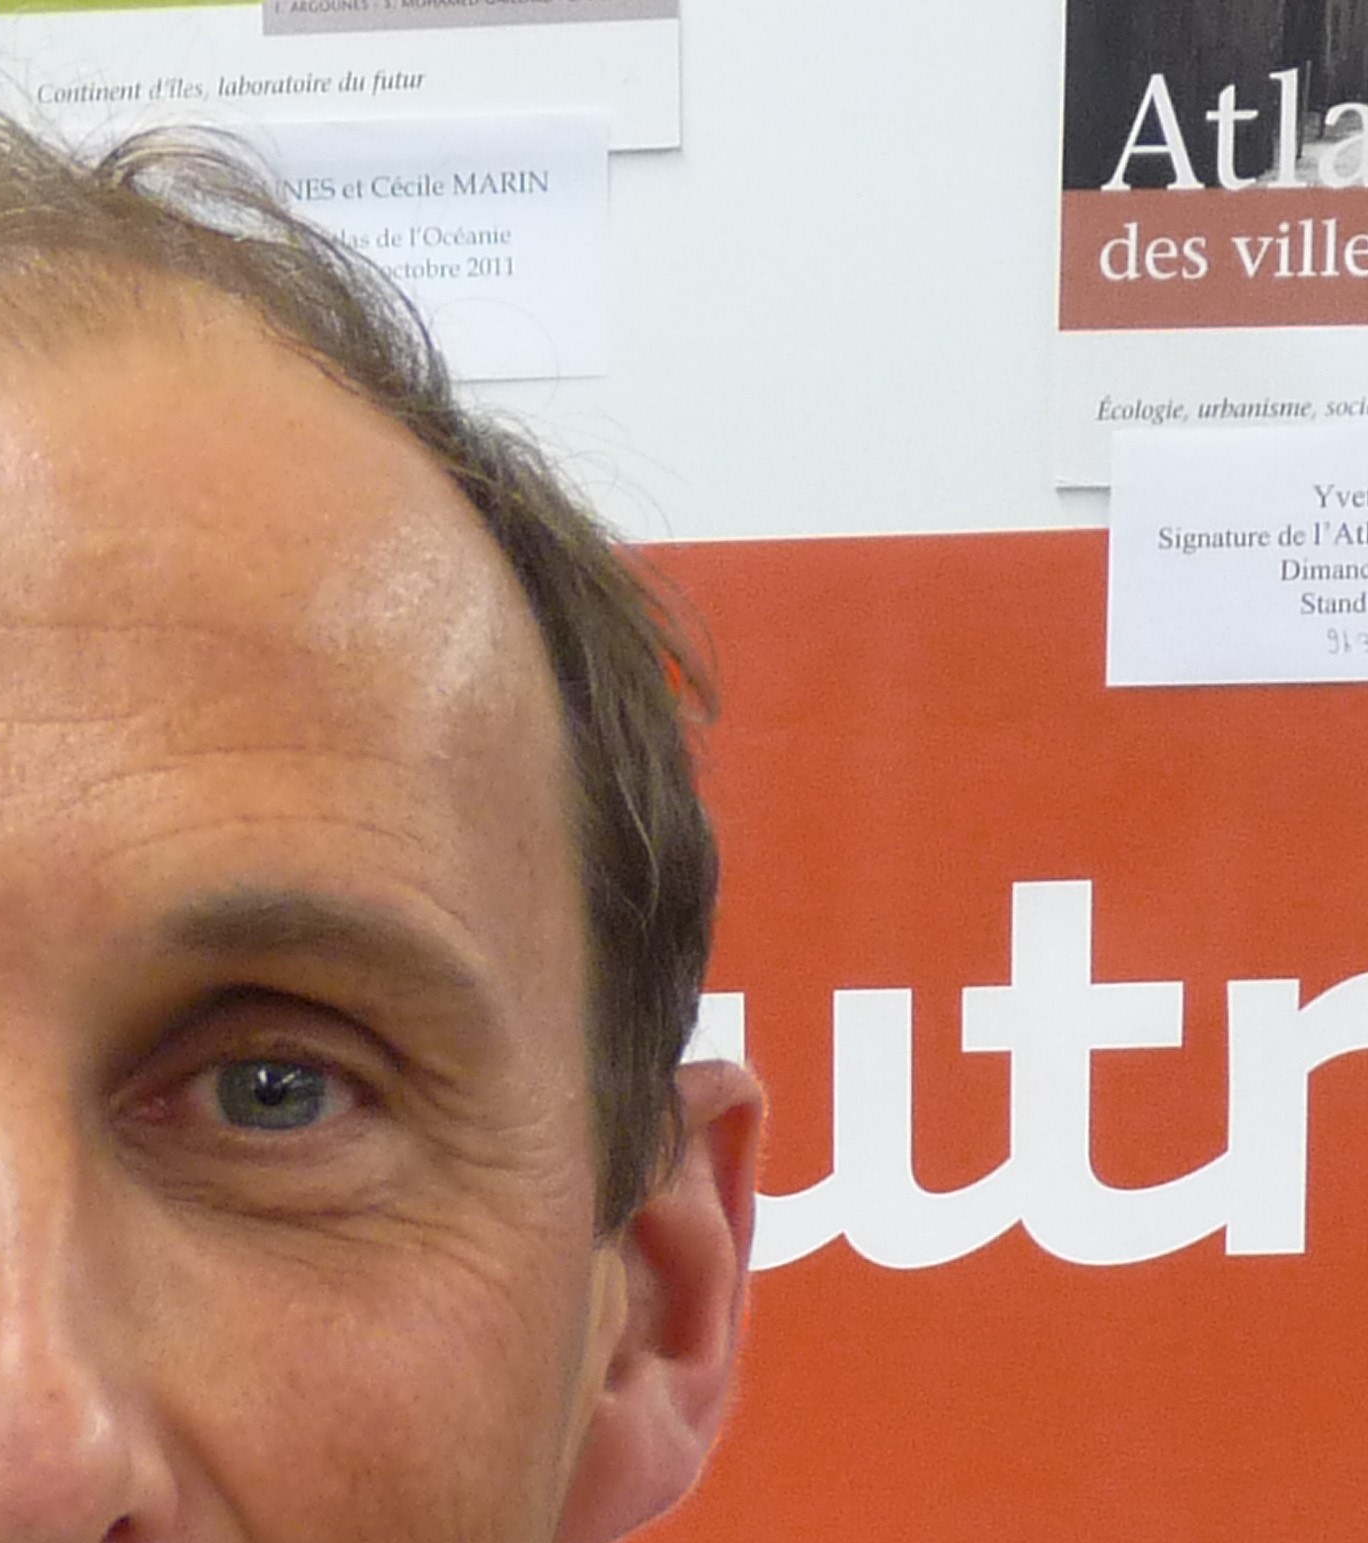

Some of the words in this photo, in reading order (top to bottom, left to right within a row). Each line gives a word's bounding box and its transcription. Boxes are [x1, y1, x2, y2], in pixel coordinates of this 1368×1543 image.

[37, 81, 141, 104] Continent
[218, 73, 332, 97] laboratoire
[338, 70, 365, 93] du
[372, 69, 425, 97] futur
[342, 181, 363, 200] et
[371, 174, 445, 199] Cécile
[452, 170, 550, 197] MARIN
[376, 228, 403, 249] de
[410, 226, 511, 249] l'Océanie
[1099, 221, 1208, 280] des
[467, 257, 514, 278] 2011
[1096, 396, 1189, 425] Écologie,
[1198, 397, 1316, 421] urbanisme,
[1324, 395, 1368, 418] soci
[1158, 525, 1271, 555] Signature
[1278, 524, 1306, 547] de
[1300, 591, 1367, 616] Stand
